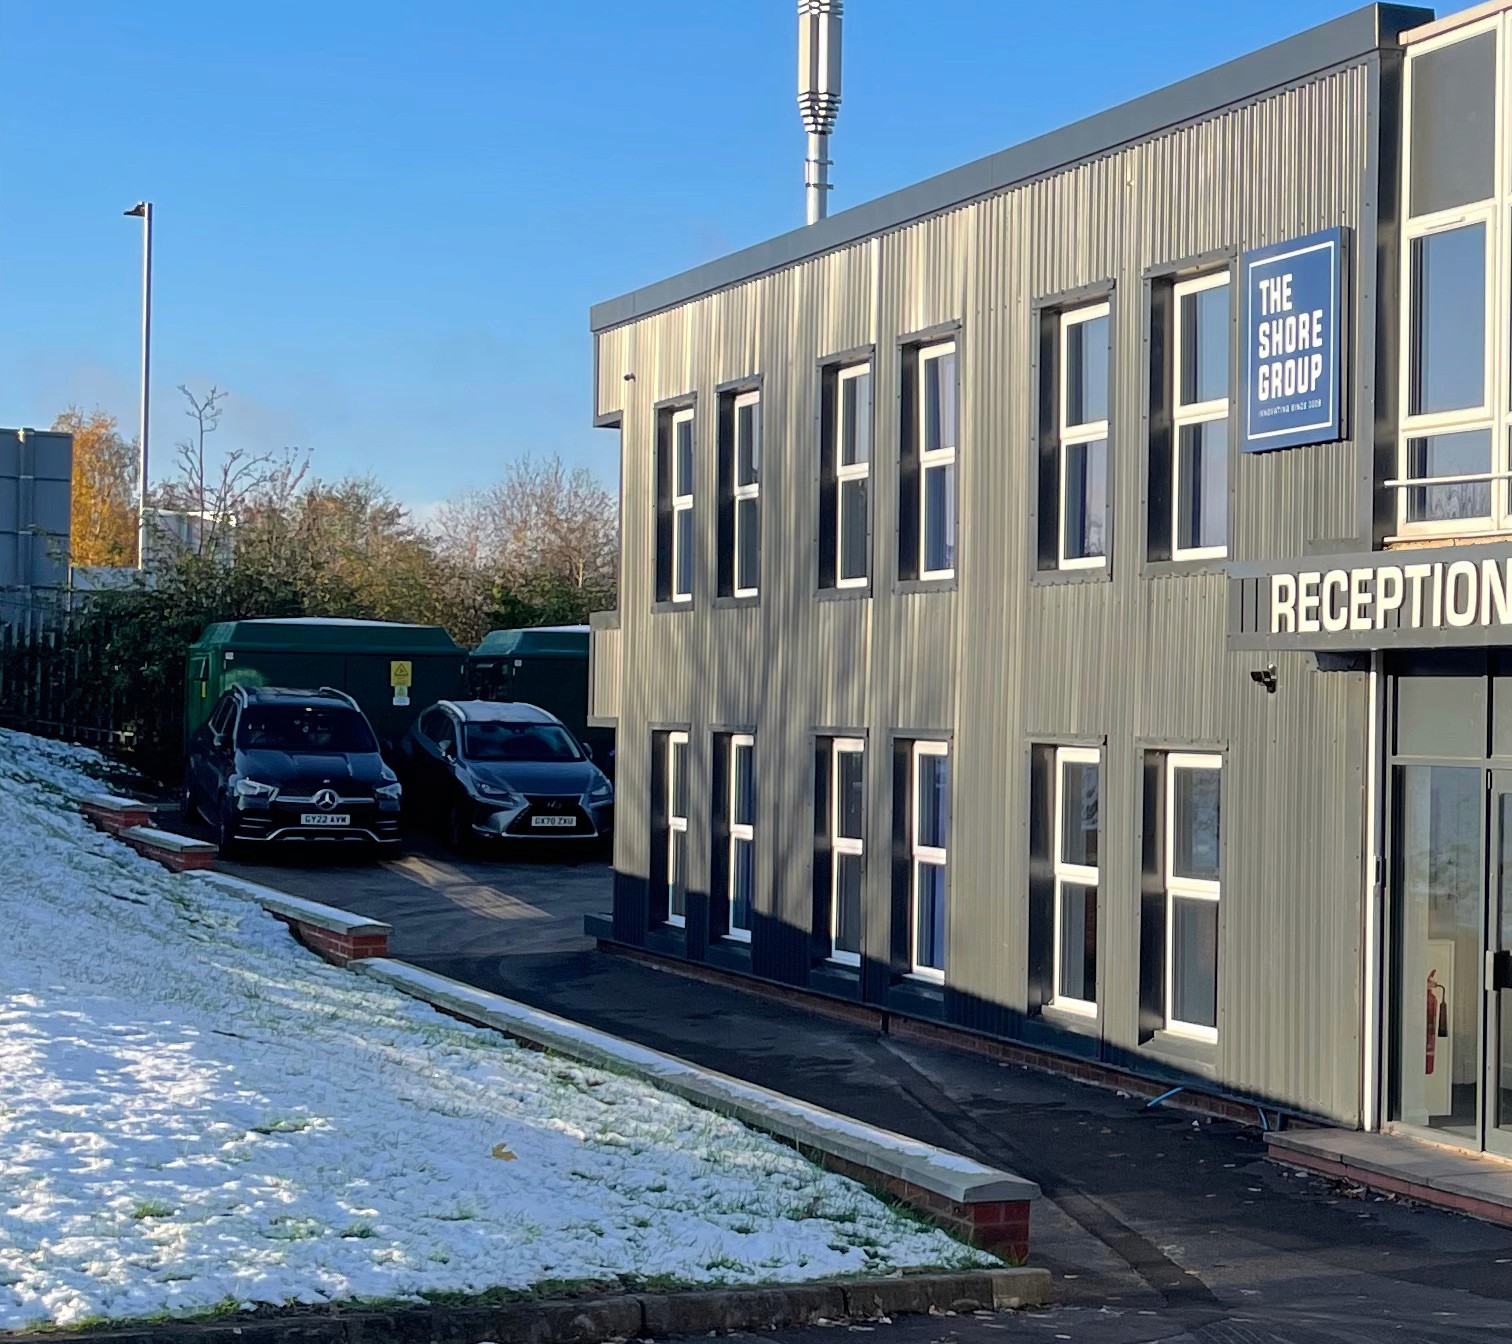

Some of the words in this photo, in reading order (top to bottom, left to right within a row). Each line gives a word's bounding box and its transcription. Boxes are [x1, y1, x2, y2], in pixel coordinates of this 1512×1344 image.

[1258, 273, 1293, 316] THE
[1258, 309, 1323, 359] SHORE
[1258, 353, 1323, 402] GROUP
